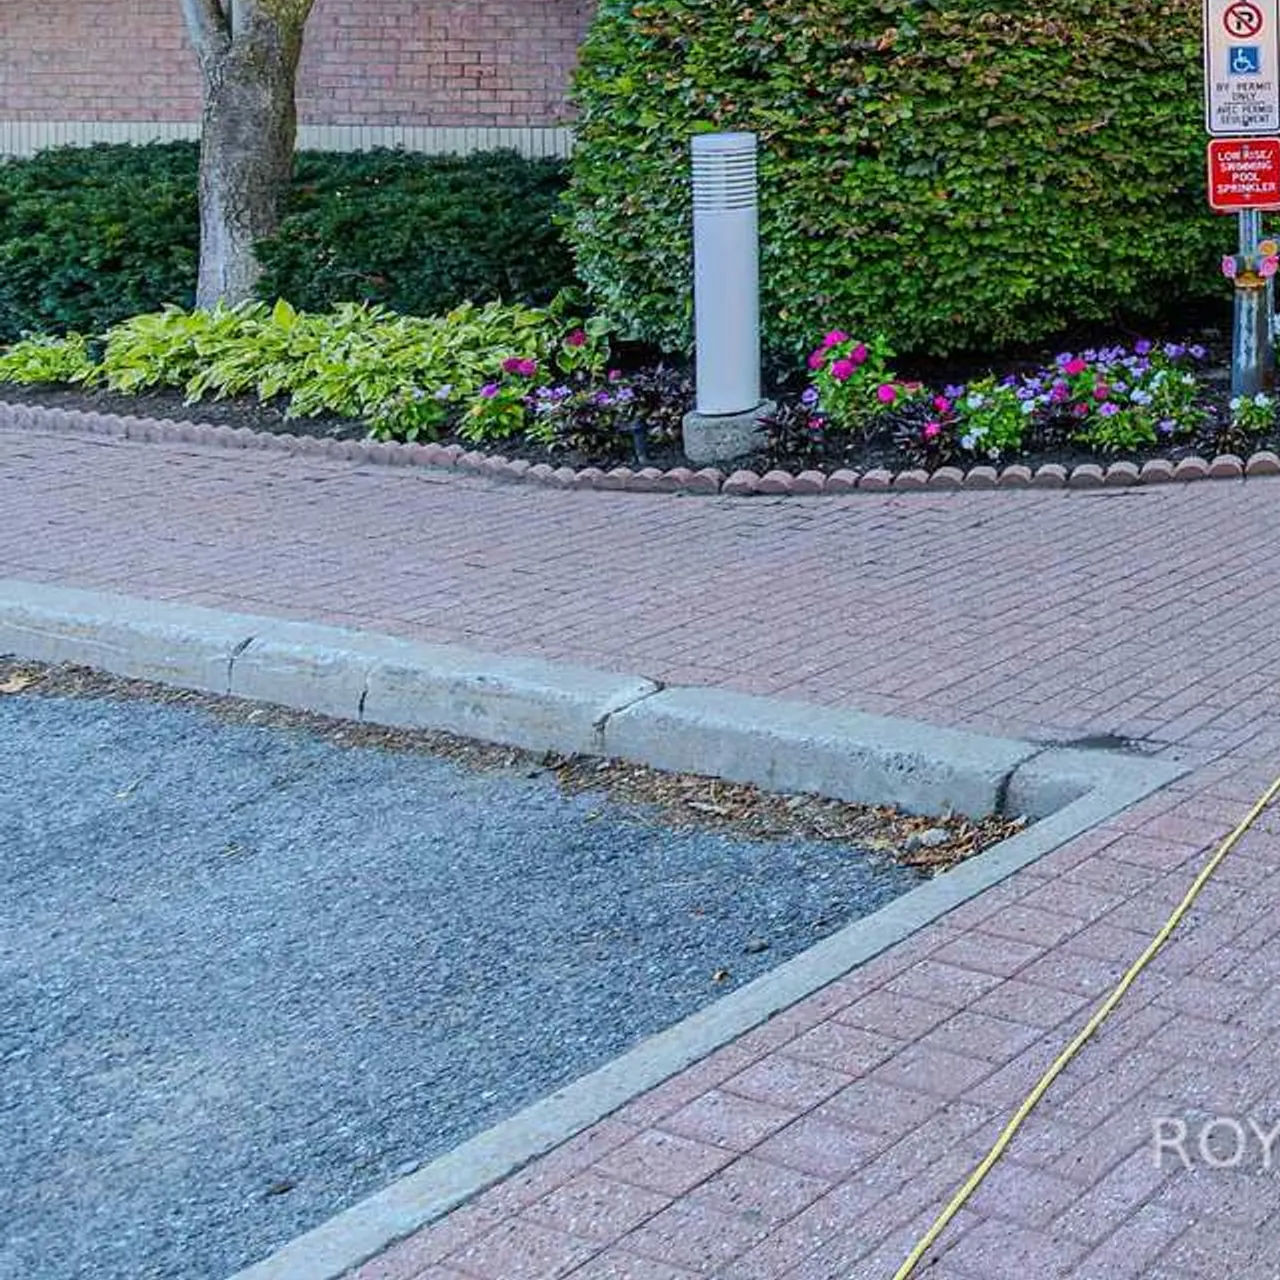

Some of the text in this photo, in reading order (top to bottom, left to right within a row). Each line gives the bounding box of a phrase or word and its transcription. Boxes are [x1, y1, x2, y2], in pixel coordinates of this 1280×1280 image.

[1216, 82, 1272, 91] BY PERMIT
[1231, 91, 1257, 101] ONLY
[1216, 105, 1238, 115] AVEC
[1220, 160, 1273, 172] SWIMMING
[1231, 171, 1261, 182] POOL
[1216, 182, 1276, 194] SPRINKLER
